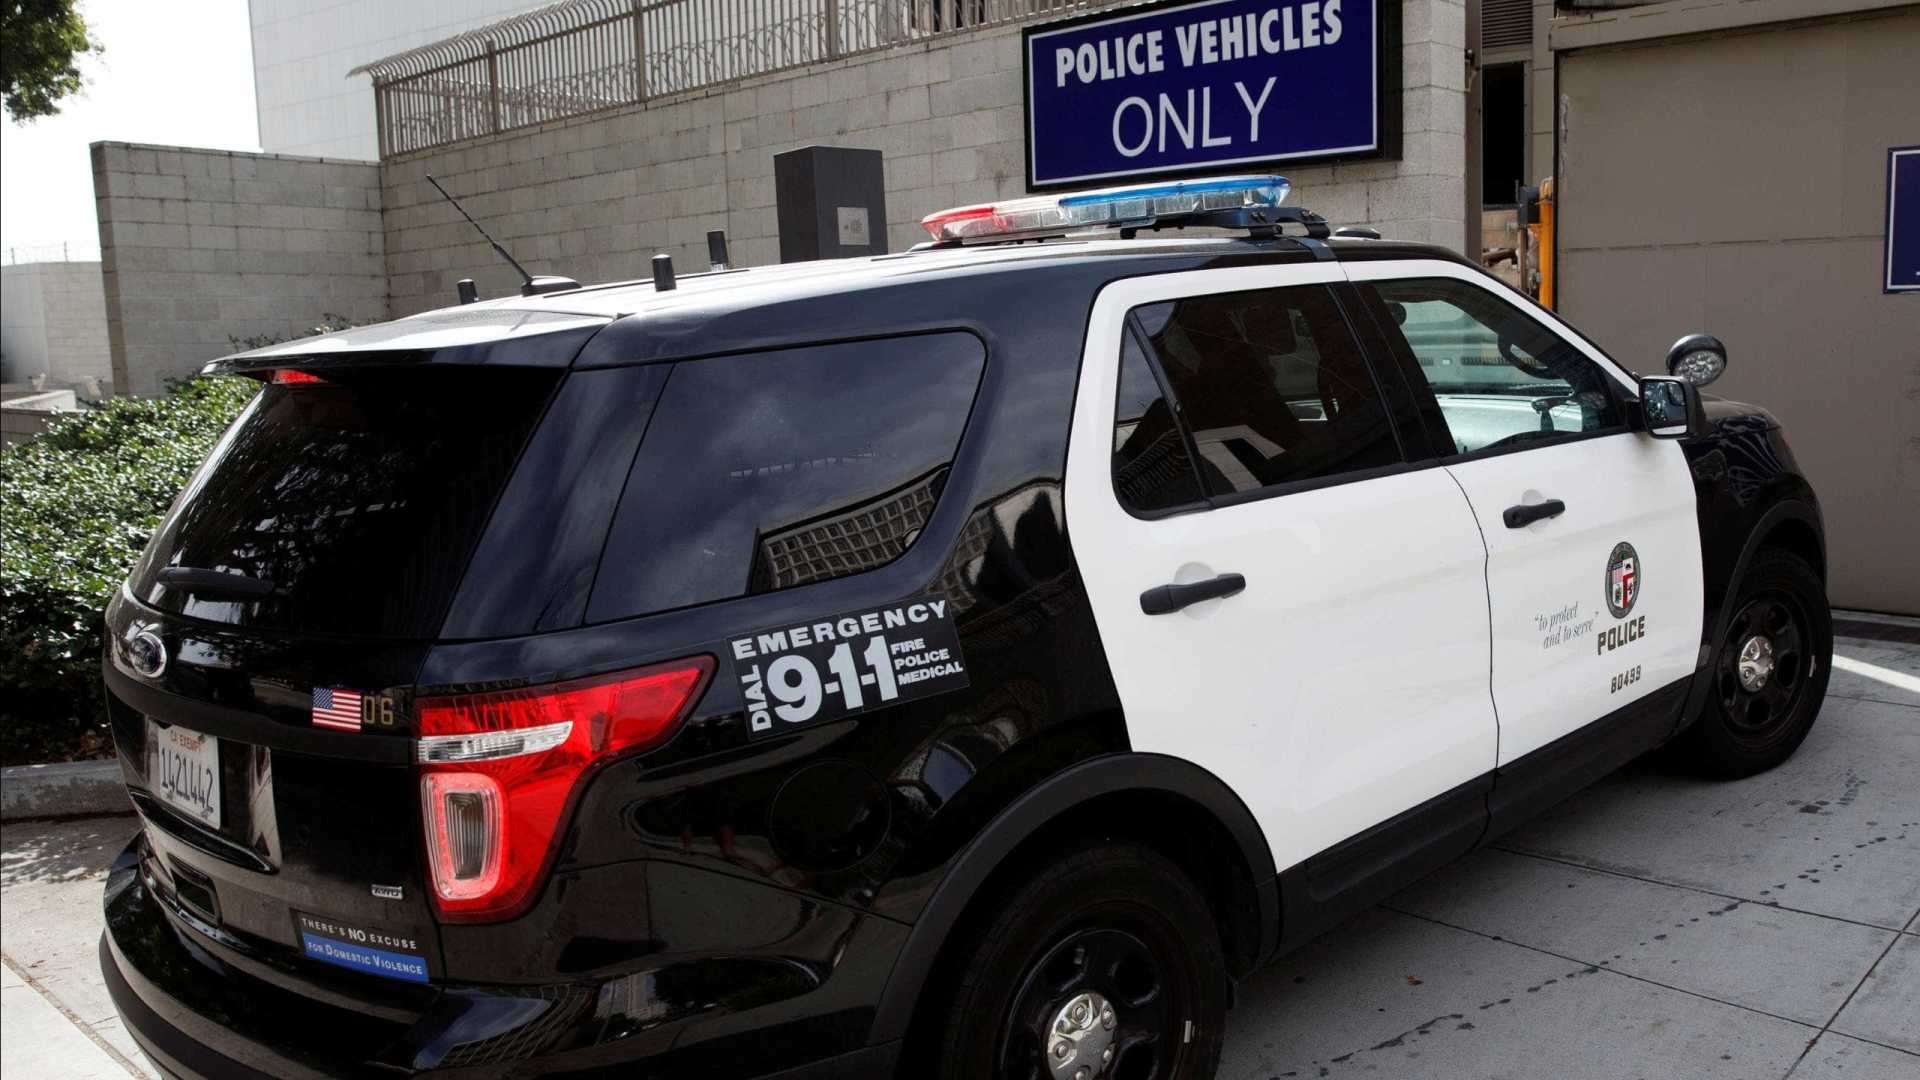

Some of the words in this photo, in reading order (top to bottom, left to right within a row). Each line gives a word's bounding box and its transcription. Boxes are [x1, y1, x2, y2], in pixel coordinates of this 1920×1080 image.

[1055, 30, 1164, 88] POLICE
[1175, 0, 1343, 67] VEHICLES
[1112, 76, 1278, 158] ONLY
[732, 599, 946, 660] EMERGENCY
[1549, 601, 1580, 632] protect
[890, 638, 926, 656] FIRE
[1543, 630, 1561, 650] and
[1597, 615, 1646, 655] POLICE
[894, 648, 950, 670] POLICE
[898, 661, 964, 685] MEDICAL
[766, 634, 899, 723] 9-1-1
[1610, 665, 1642, 694] 80499
[363, 696, 394, 725] 06
[741, 664, 772, 732] DIAL
[161, 746, 214, 814] 1421442
[302, 917, 346, 936] THERE'S
[347, 927, 366, 942] NO
[369, 934, 417, 950] EXCUSE
[307, 941, 324, 954] FOR
[325, 944, 371, 965] DOMESTIC
[372, 954, 423, 975] VIOLENCE
